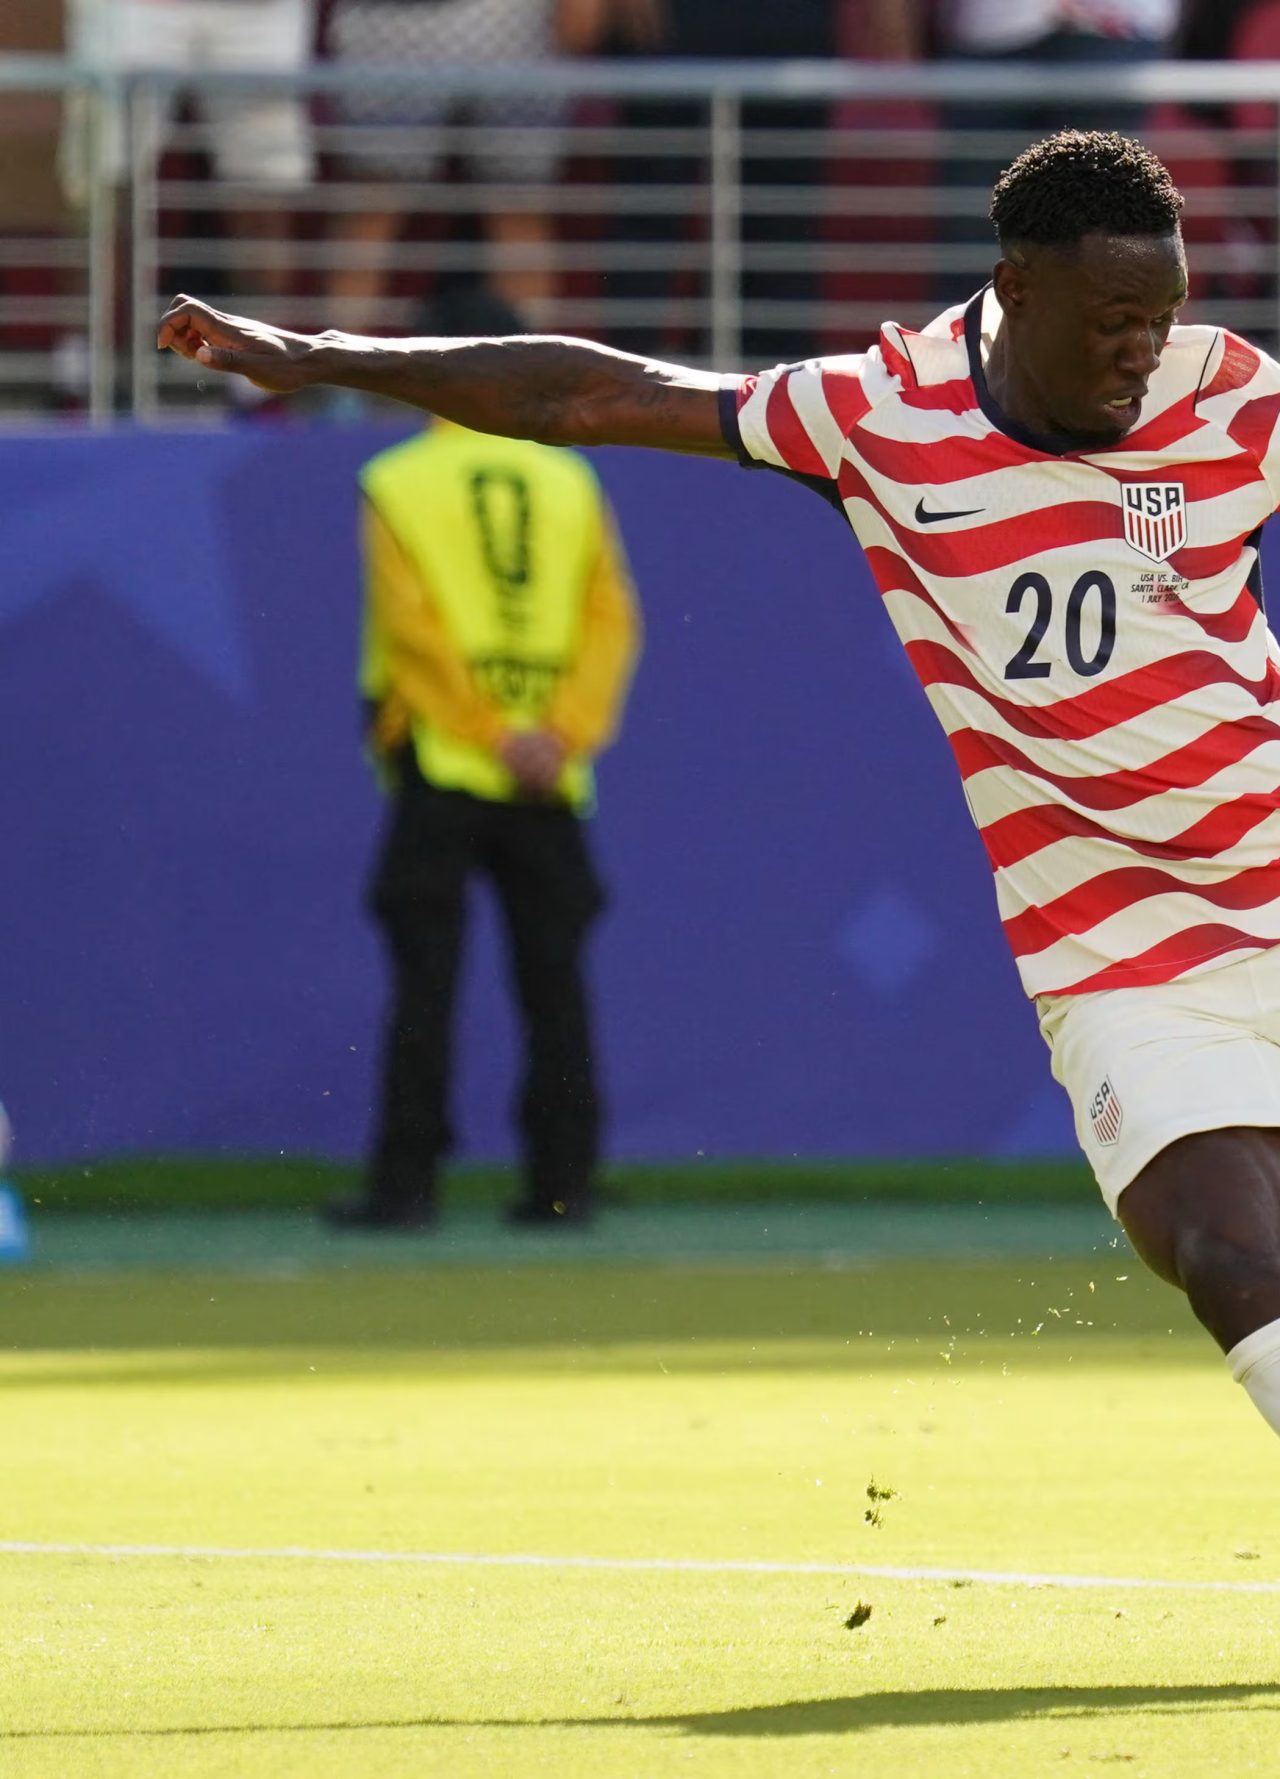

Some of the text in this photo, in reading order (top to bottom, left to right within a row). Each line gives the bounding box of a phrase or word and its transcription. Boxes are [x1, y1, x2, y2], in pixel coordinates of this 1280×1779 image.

[1126, 487, 1180, 516] USA
[1140, 574, 1155, 582] USA
[1131, 584, 1154, 593] SANTA
[1147, 594, 1162, 603] JULY
[1004, 570, 1116, 680] 20
[1090, 1081, 1110, 1120] USA
